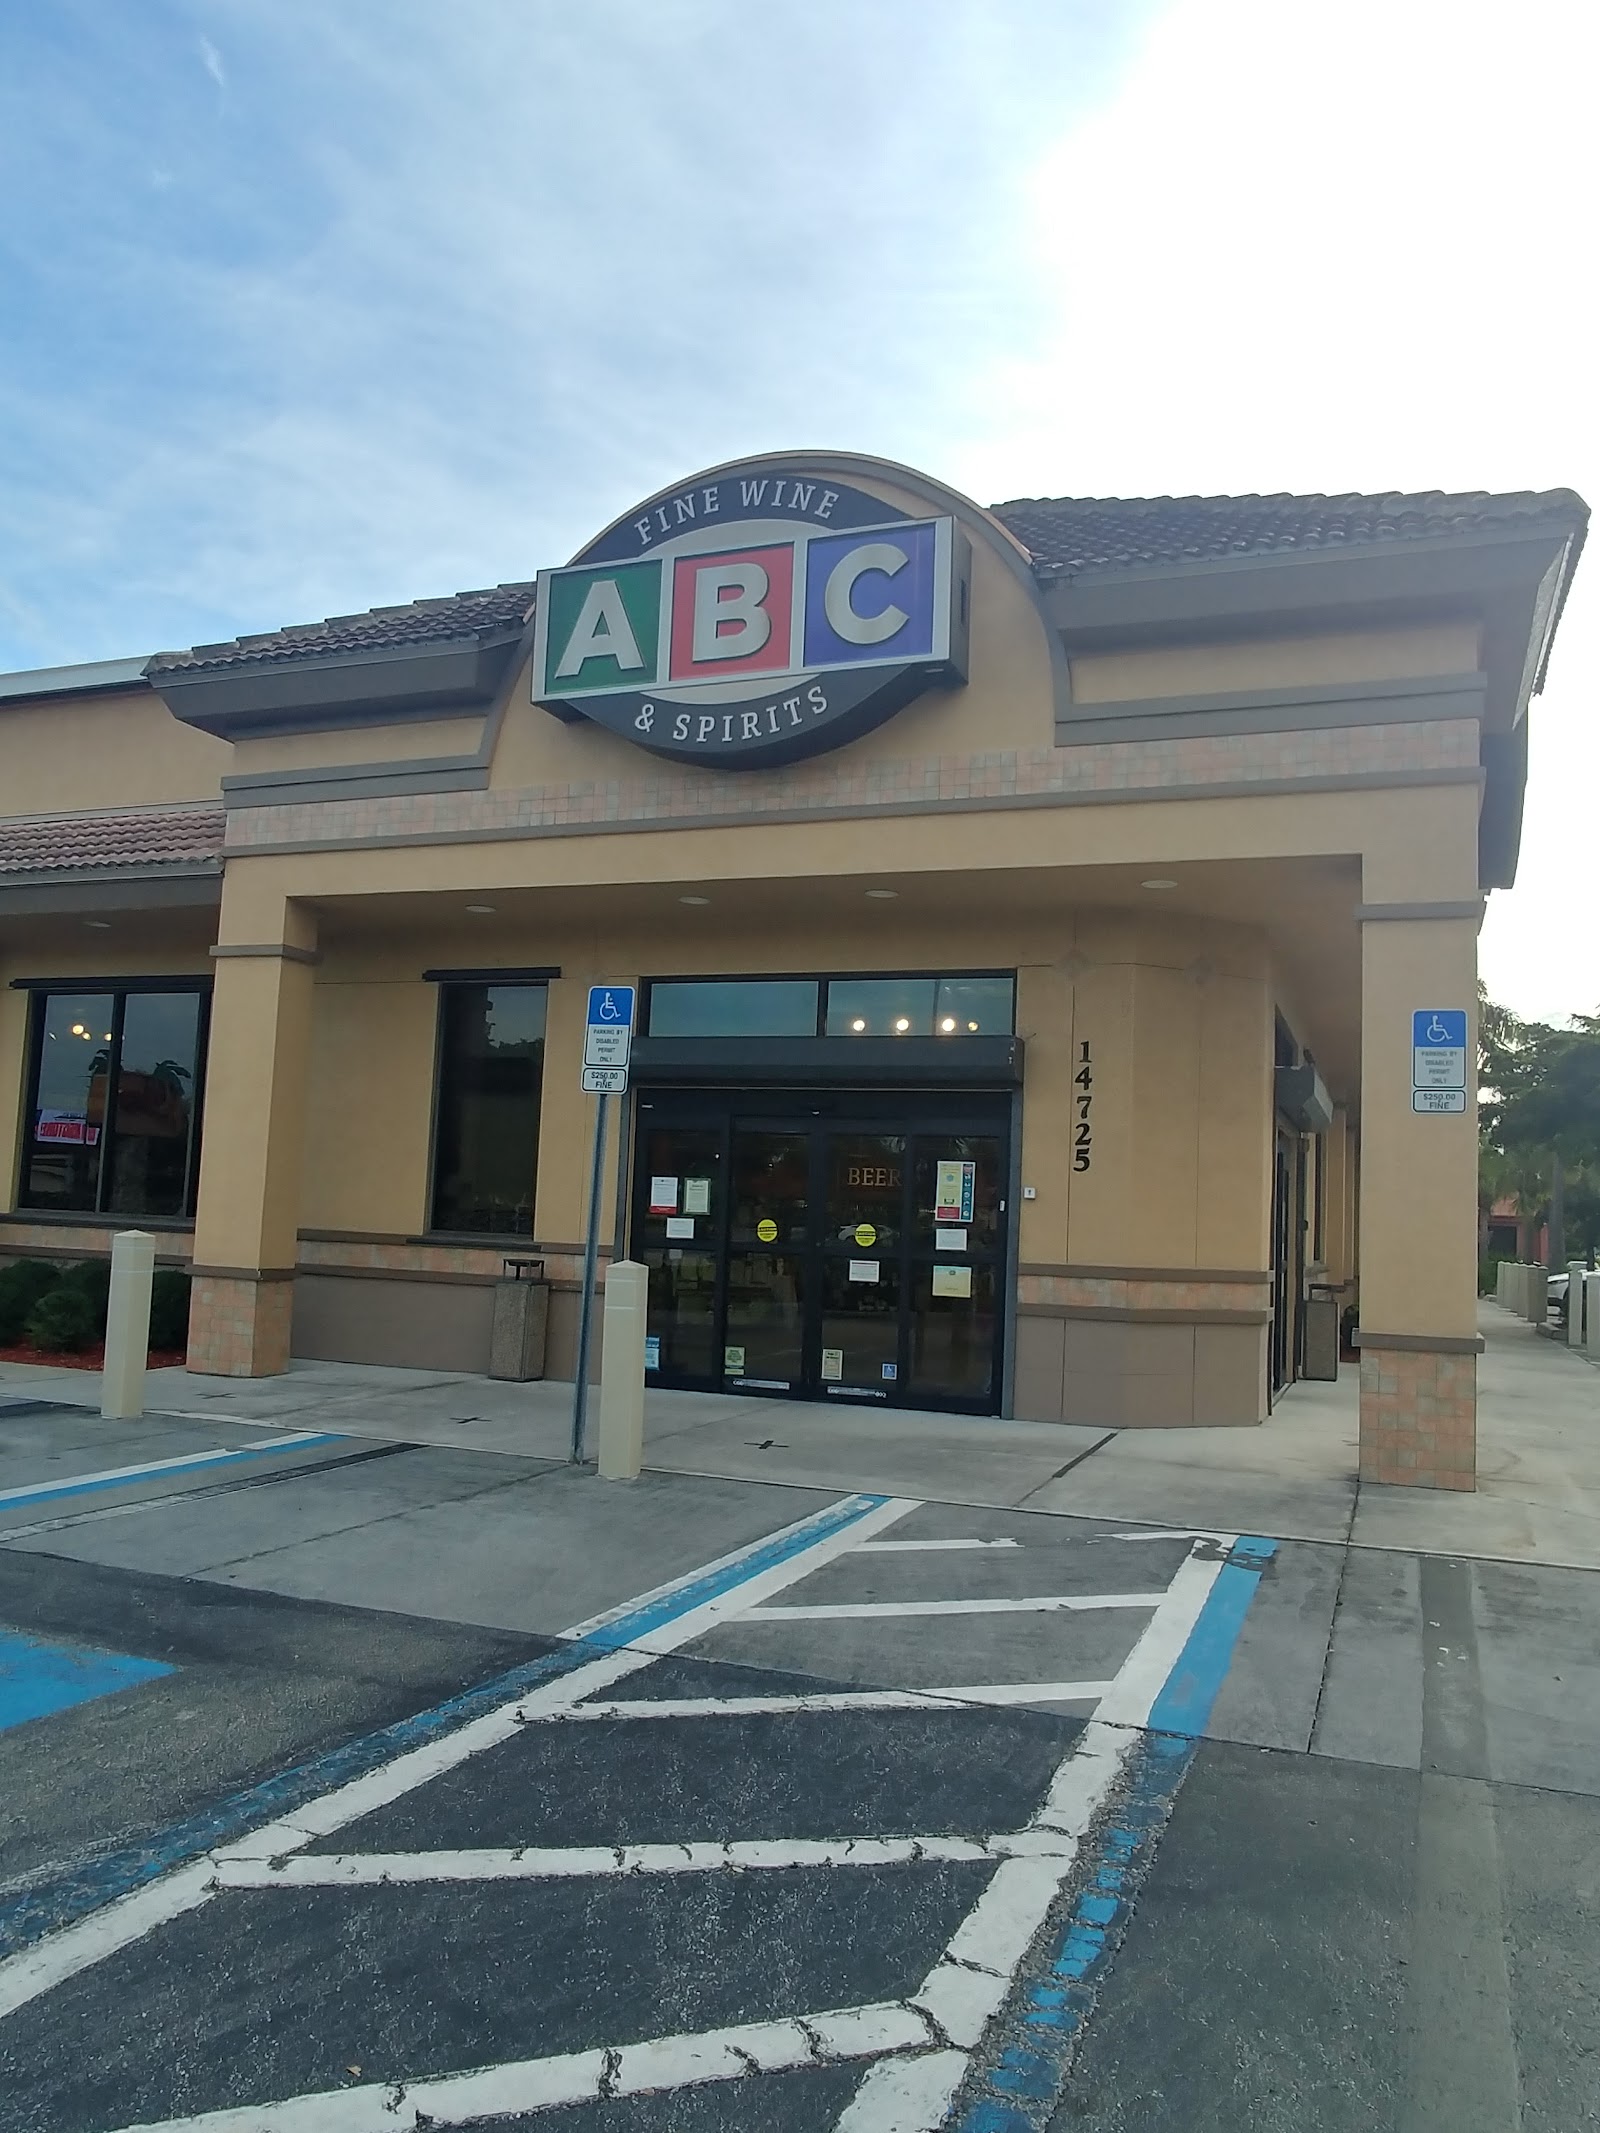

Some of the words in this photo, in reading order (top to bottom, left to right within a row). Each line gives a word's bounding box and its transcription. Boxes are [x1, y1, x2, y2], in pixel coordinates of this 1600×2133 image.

[634, 487, 720, 545] FINE
[739, 480, 840, 519] WINE
[554, 543, 910, 679] ABC
[634, 703, 656, 732] &
[672, 686, 828, 742] SPIRITS
[595, 1081, 613, 1089] FINE
[1423, 1093, 1456, 1101] $250.00
[1073, 1040, 1093, 1172] 14725
[1429, 1102, 1450, 1110] FINE
[847, 1167, 903, 1187] BEER
